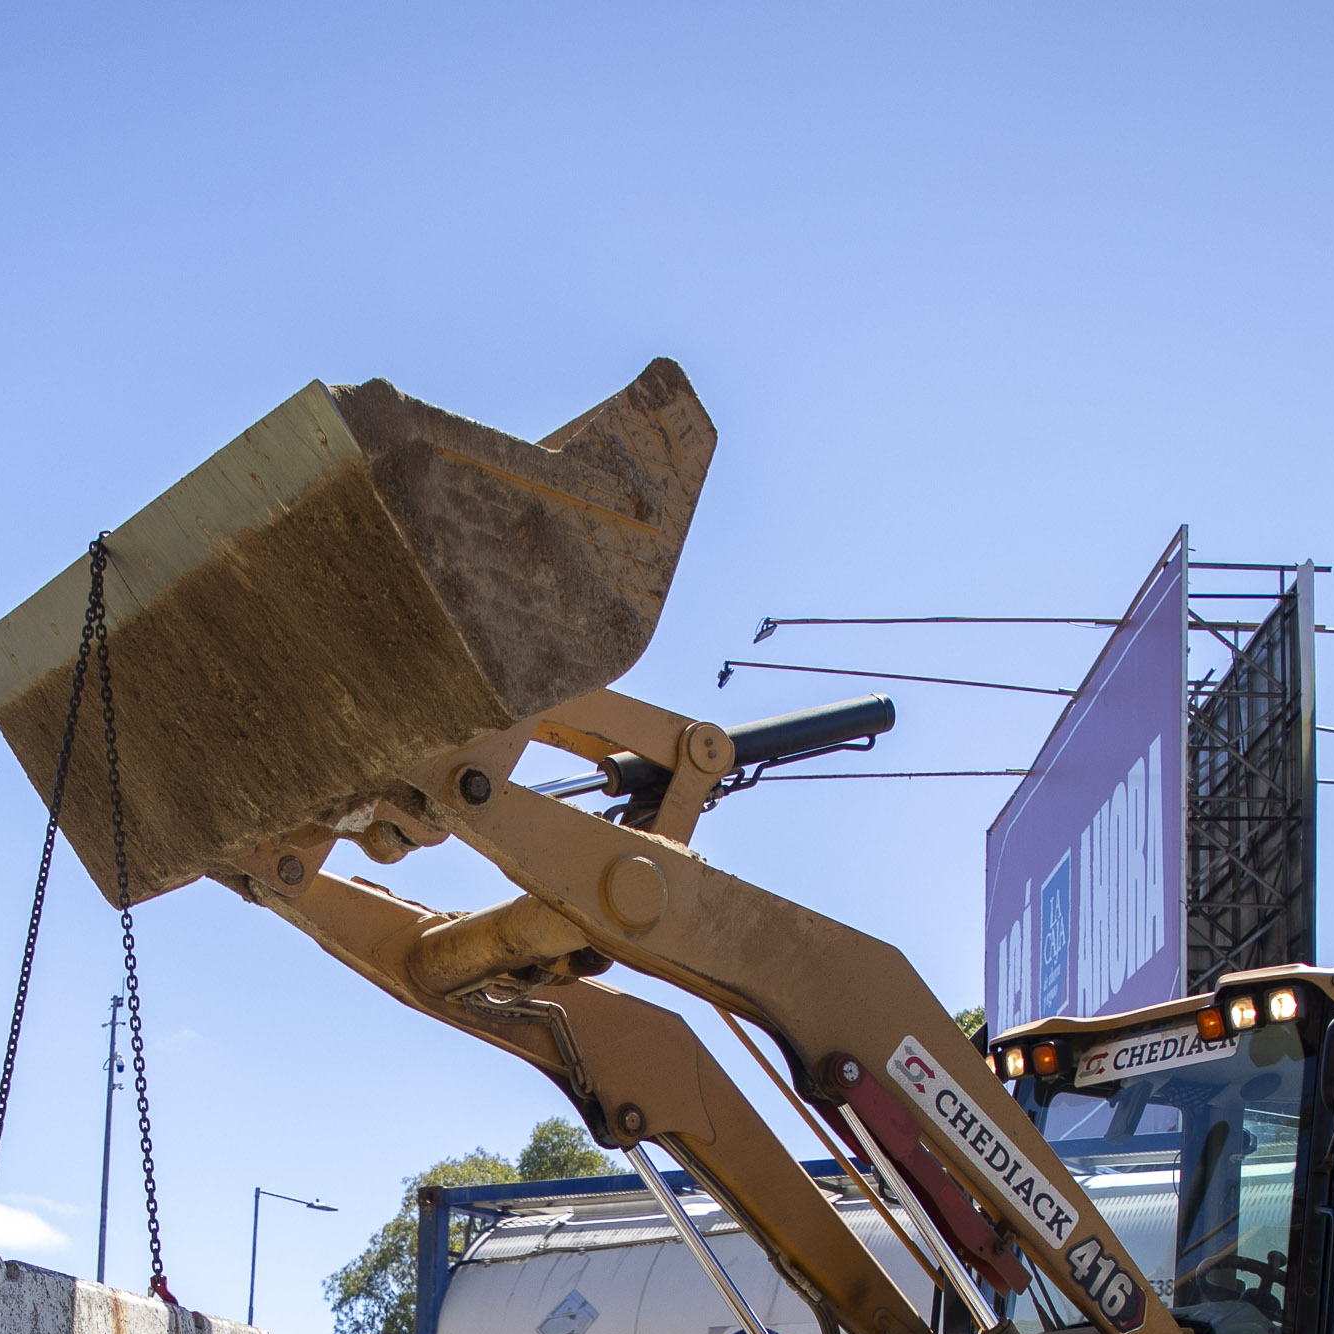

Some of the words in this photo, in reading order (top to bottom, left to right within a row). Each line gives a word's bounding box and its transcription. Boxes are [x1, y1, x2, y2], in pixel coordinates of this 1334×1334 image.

[1049, 889, 1062, 929] LA
[1077, 734, 1165, 1018] AHORA
[1043, 916, 1066, 965] CAJA
[935, 1089, 1073, 1241] CHEDIACK
[1069, 1239, 1133, 1318] 416
